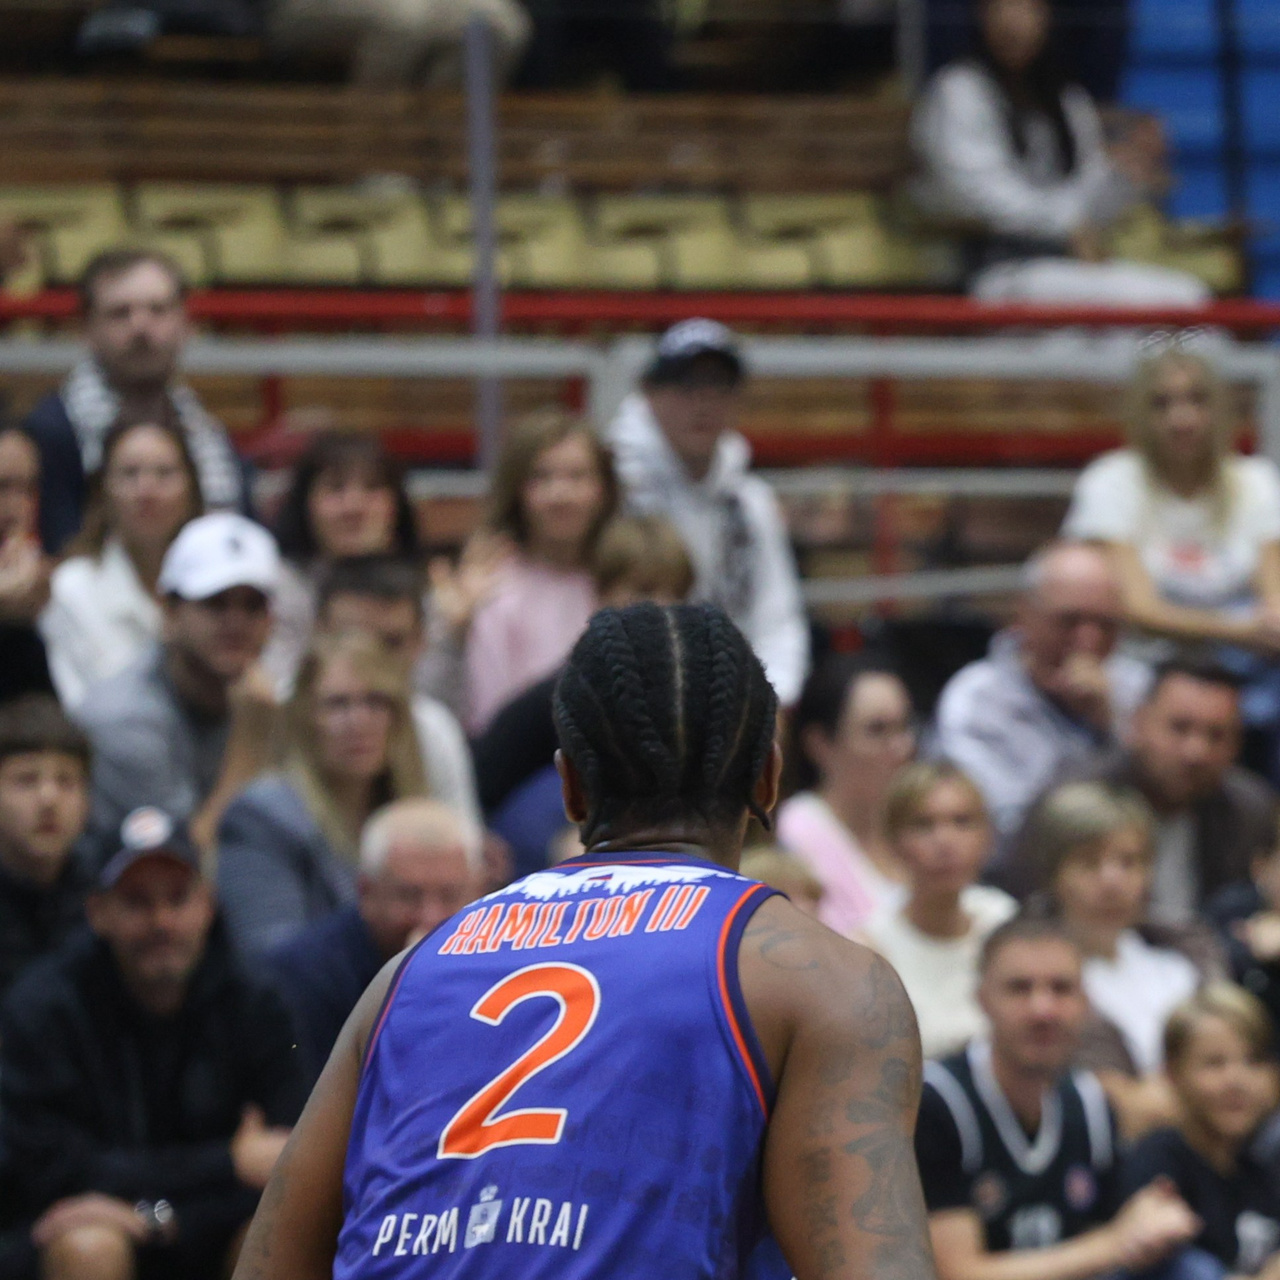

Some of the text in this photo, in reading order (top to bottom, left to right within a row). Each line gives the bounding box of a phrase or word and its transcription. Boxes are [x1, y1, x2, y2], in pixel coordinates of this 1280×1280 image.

[437, 885, 711, 955] HAMILTON III
[437, 961, 602, 1160] 2
[372, 1196, 589, 1257] PERM KRAI
